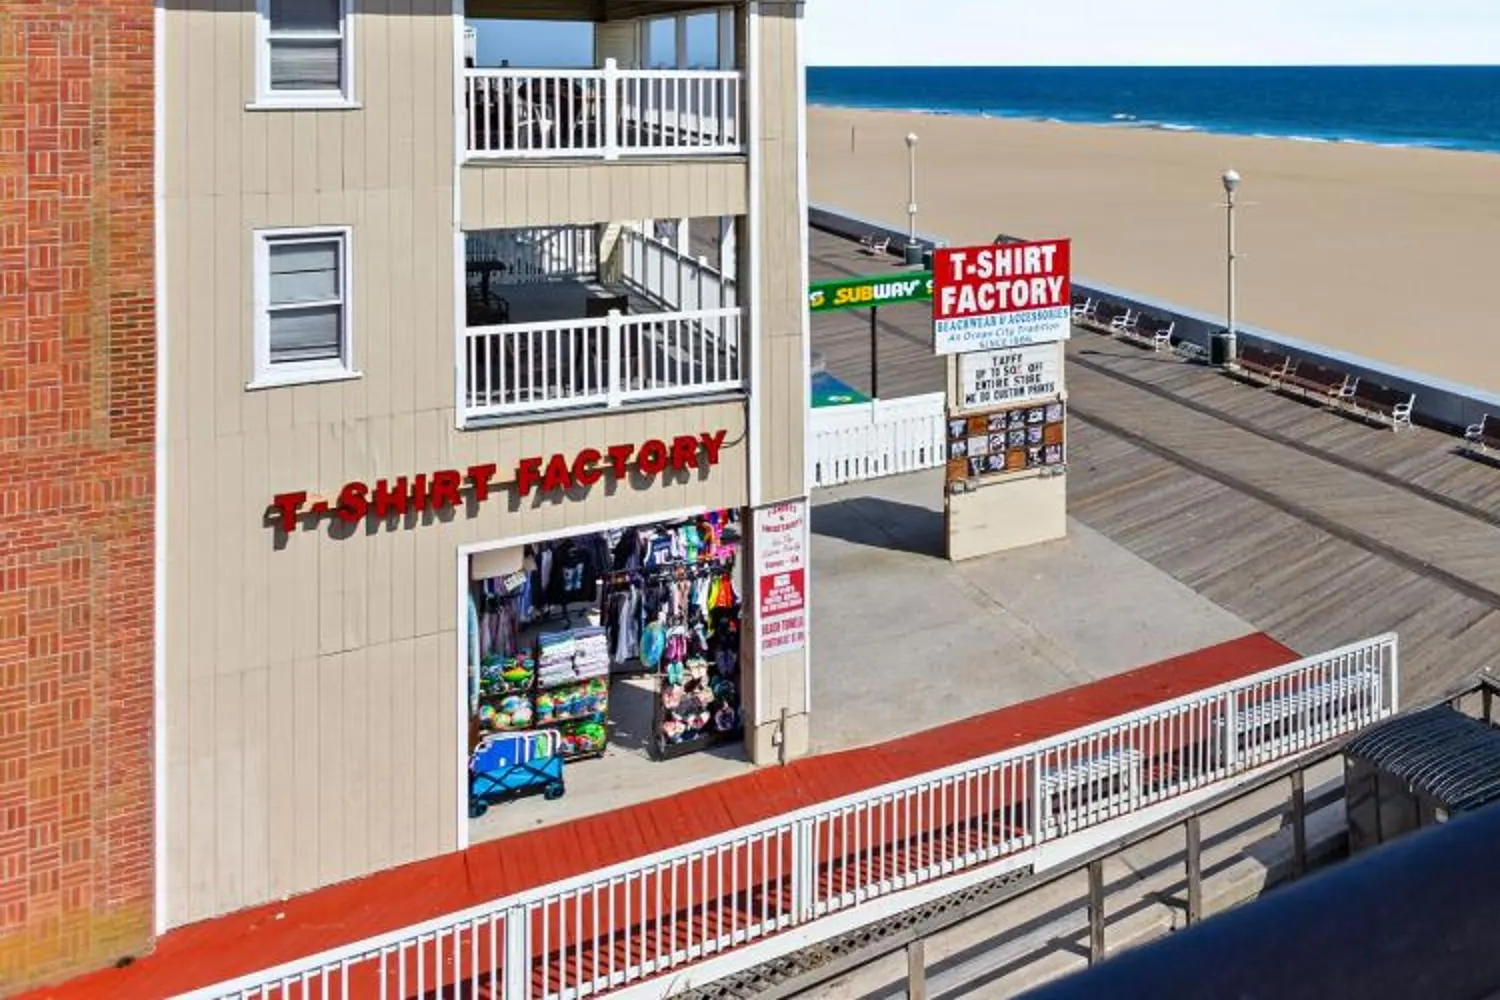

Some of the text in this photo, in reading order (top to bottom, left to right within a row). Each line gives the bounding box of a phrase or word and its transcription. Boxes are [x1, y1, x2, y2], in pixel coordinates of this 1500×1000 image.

[949, 244, 1057, 280] T-SHIRT
[833, 280, 920, 305] SUBWAY
[941, 276, 1065, 315] FACTORY
[1008, 309, 1069, 325] ACCESSORIES
[963, 331, 993, 342] Ocean
[996, 327, 1015, 339] City
[992, 353, 1023, 367] TAFFY
[975, 369, 986, 380] UP
[991, 367, 1000, 377] TO
[1027, 362, 1044, 373] OFF
[975, 373, 1041, 391] ENTIRE STORE
[993, 386, 1025, 400] CUSTOM
[1028, 382, 1056, 395] PRINTS
[273, 429, 728, 532] T-SHIRT FACTORY
